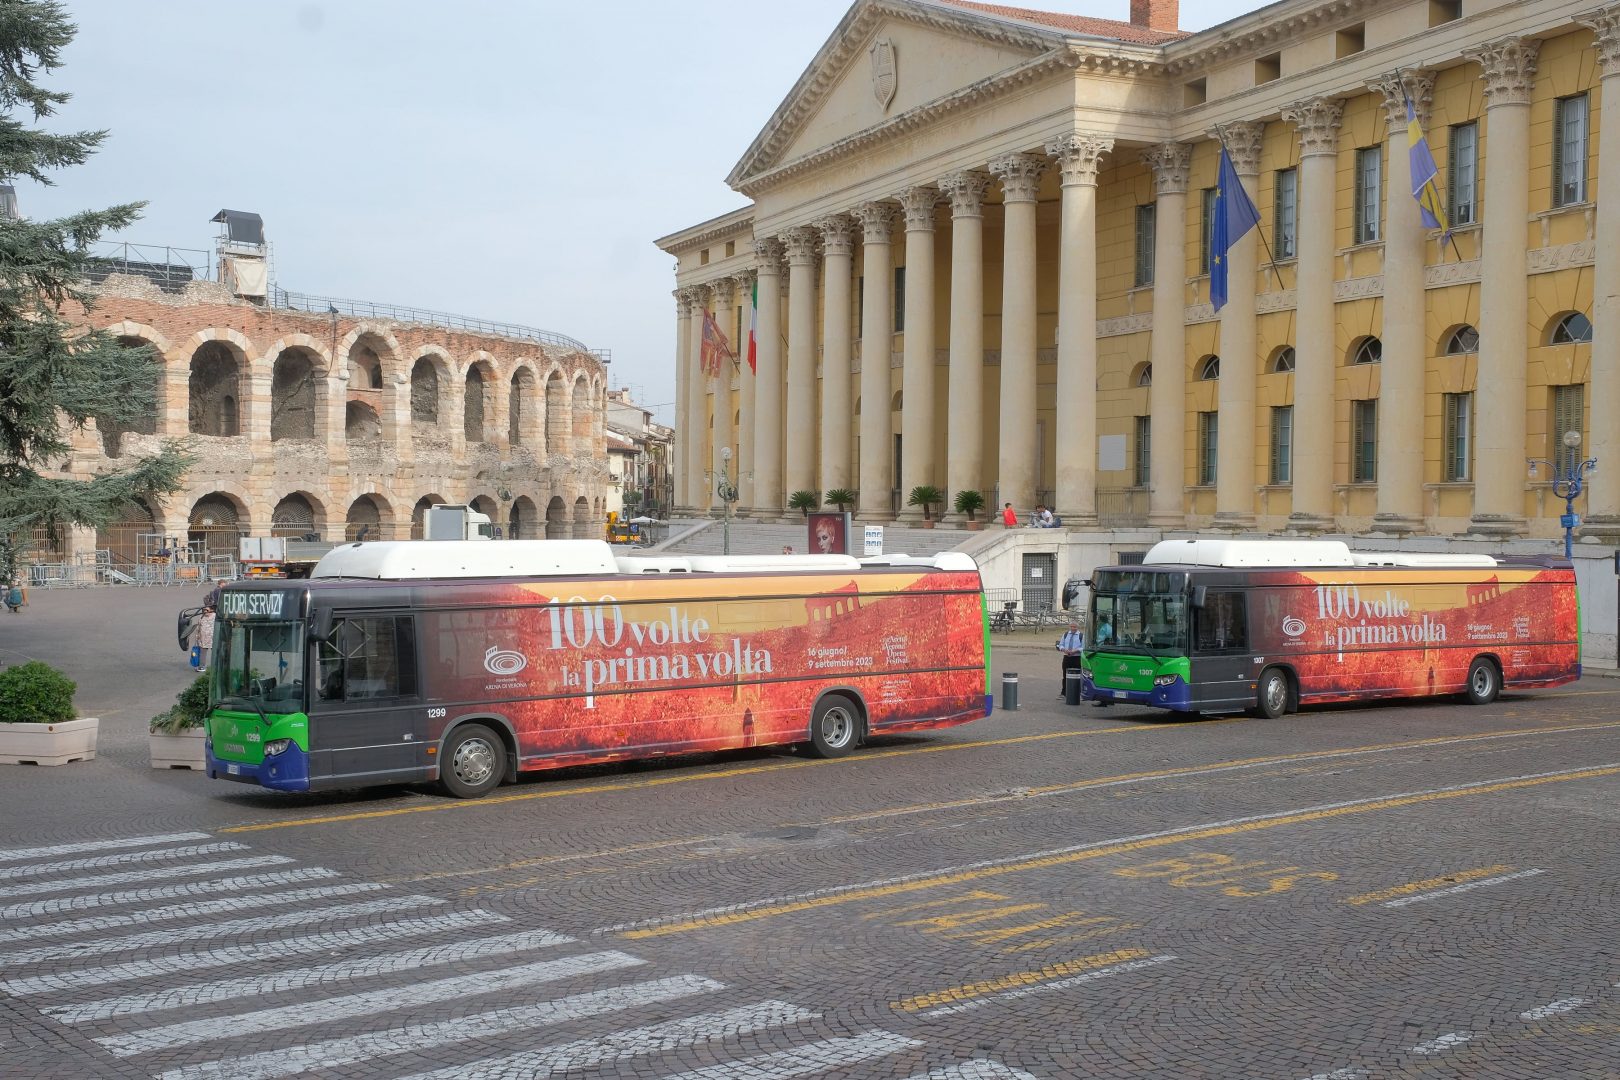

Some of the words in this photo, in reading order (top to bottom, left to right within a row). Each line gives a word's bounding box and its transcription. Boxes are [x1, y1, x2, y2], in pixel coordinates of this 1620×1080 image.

[223, 593, 247, 614] FUORI
[249, 593, 284, 615] SERVIZI
[1312, 581, 1360, 620] 100
[1362, 590, 1410, 619] volte
[539, 594, 623, 650] 100
[628, 606, 710, 646] volte
[807, 648, 816, 657] 16
[1325, 630, 1335, 646] la
[1337, 618, 1400, 663] prima
[1401, 614, 1447, 643] volta
[560, 665, 580, 686] la
[582, 647, 692, 709] prima
[695, 637, 773, 679] volta
[808, 661, 813, 669] 9
[815, 657, 854, 669] settembre
[855, 657, 873, 667] 2023
[427, 708, 446, 718] 1299
[246, 733, 260, 742] 1299
[1111, 852, 1339, 897] BUS
